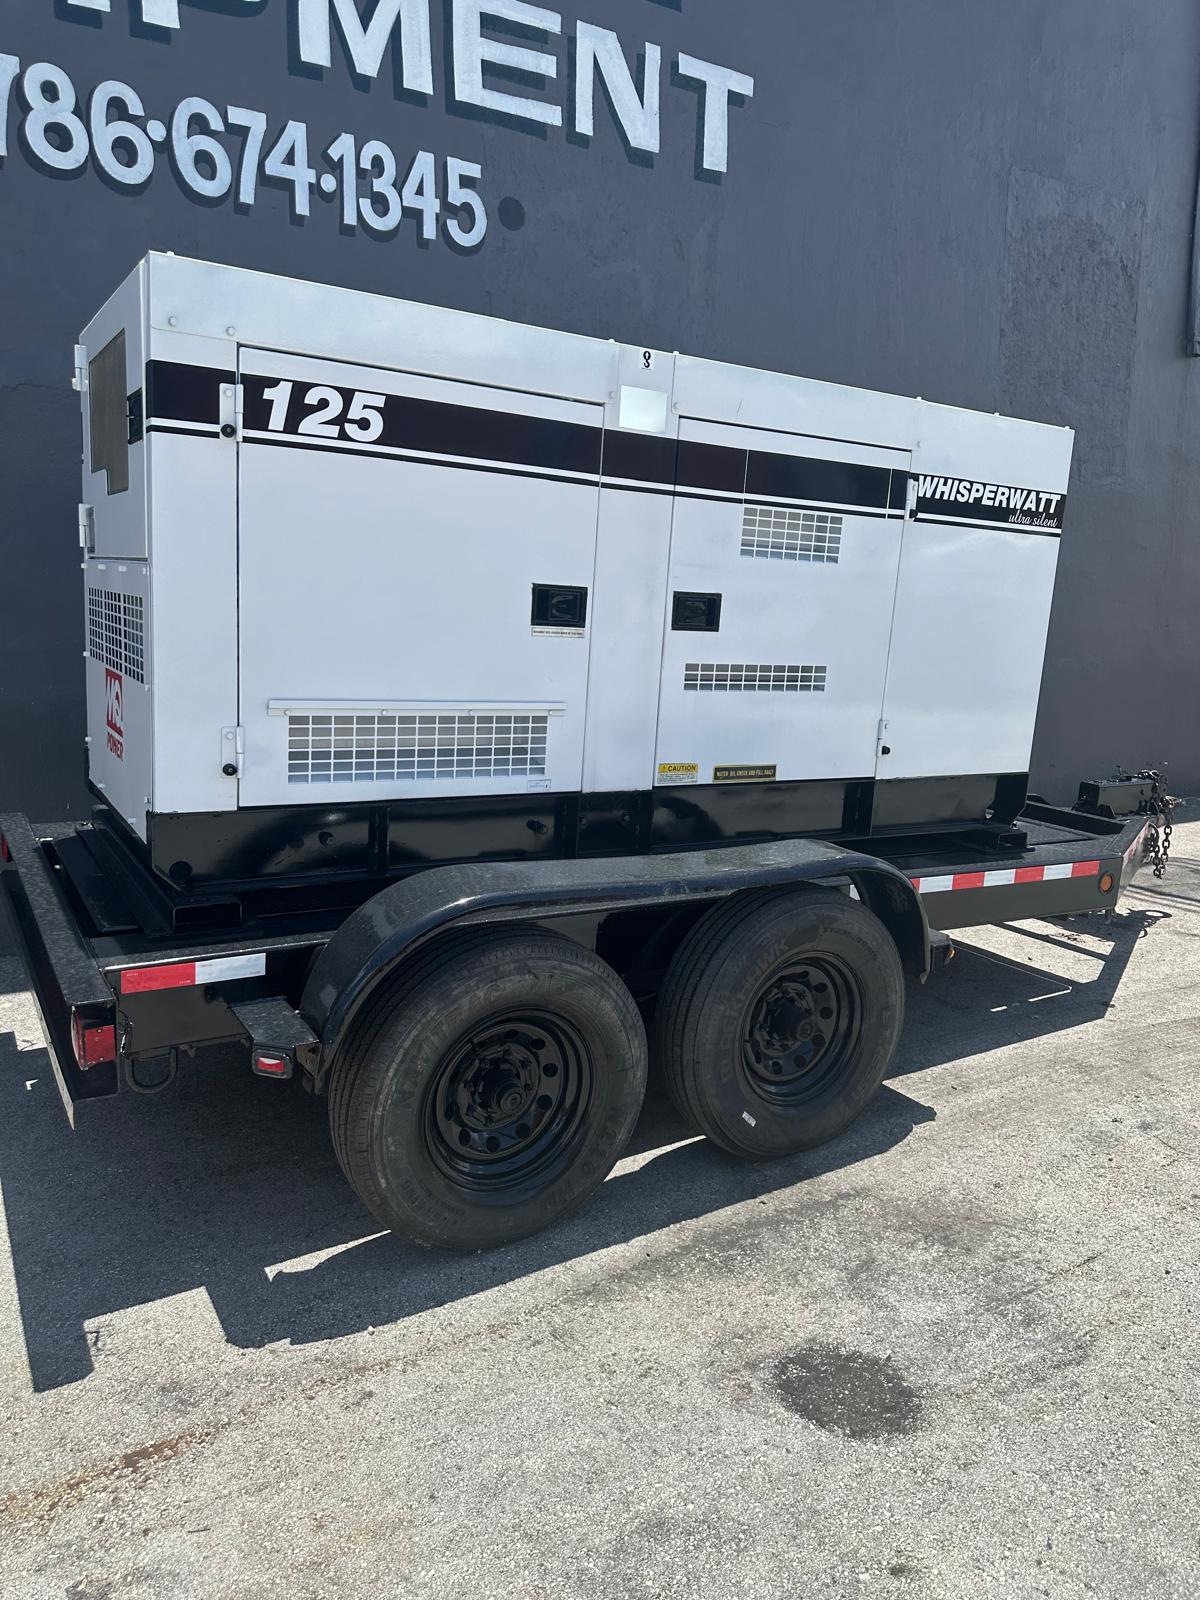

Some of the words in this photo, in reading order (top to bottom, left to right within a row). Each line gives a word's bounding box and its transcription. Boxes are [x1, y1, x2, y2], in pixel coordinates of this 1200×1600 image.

[68, 0, 754, 173] MENT
[262, 380, 386, 442] 125
[917, 475, 1061, 514] WHISPERWATT
[1008, 510, 1032, 524] ultra
[1032, 513, 1058, 527] silent
[106, 731, 124, 762] POWER
[667, 764, 697, 772] CAUTION
